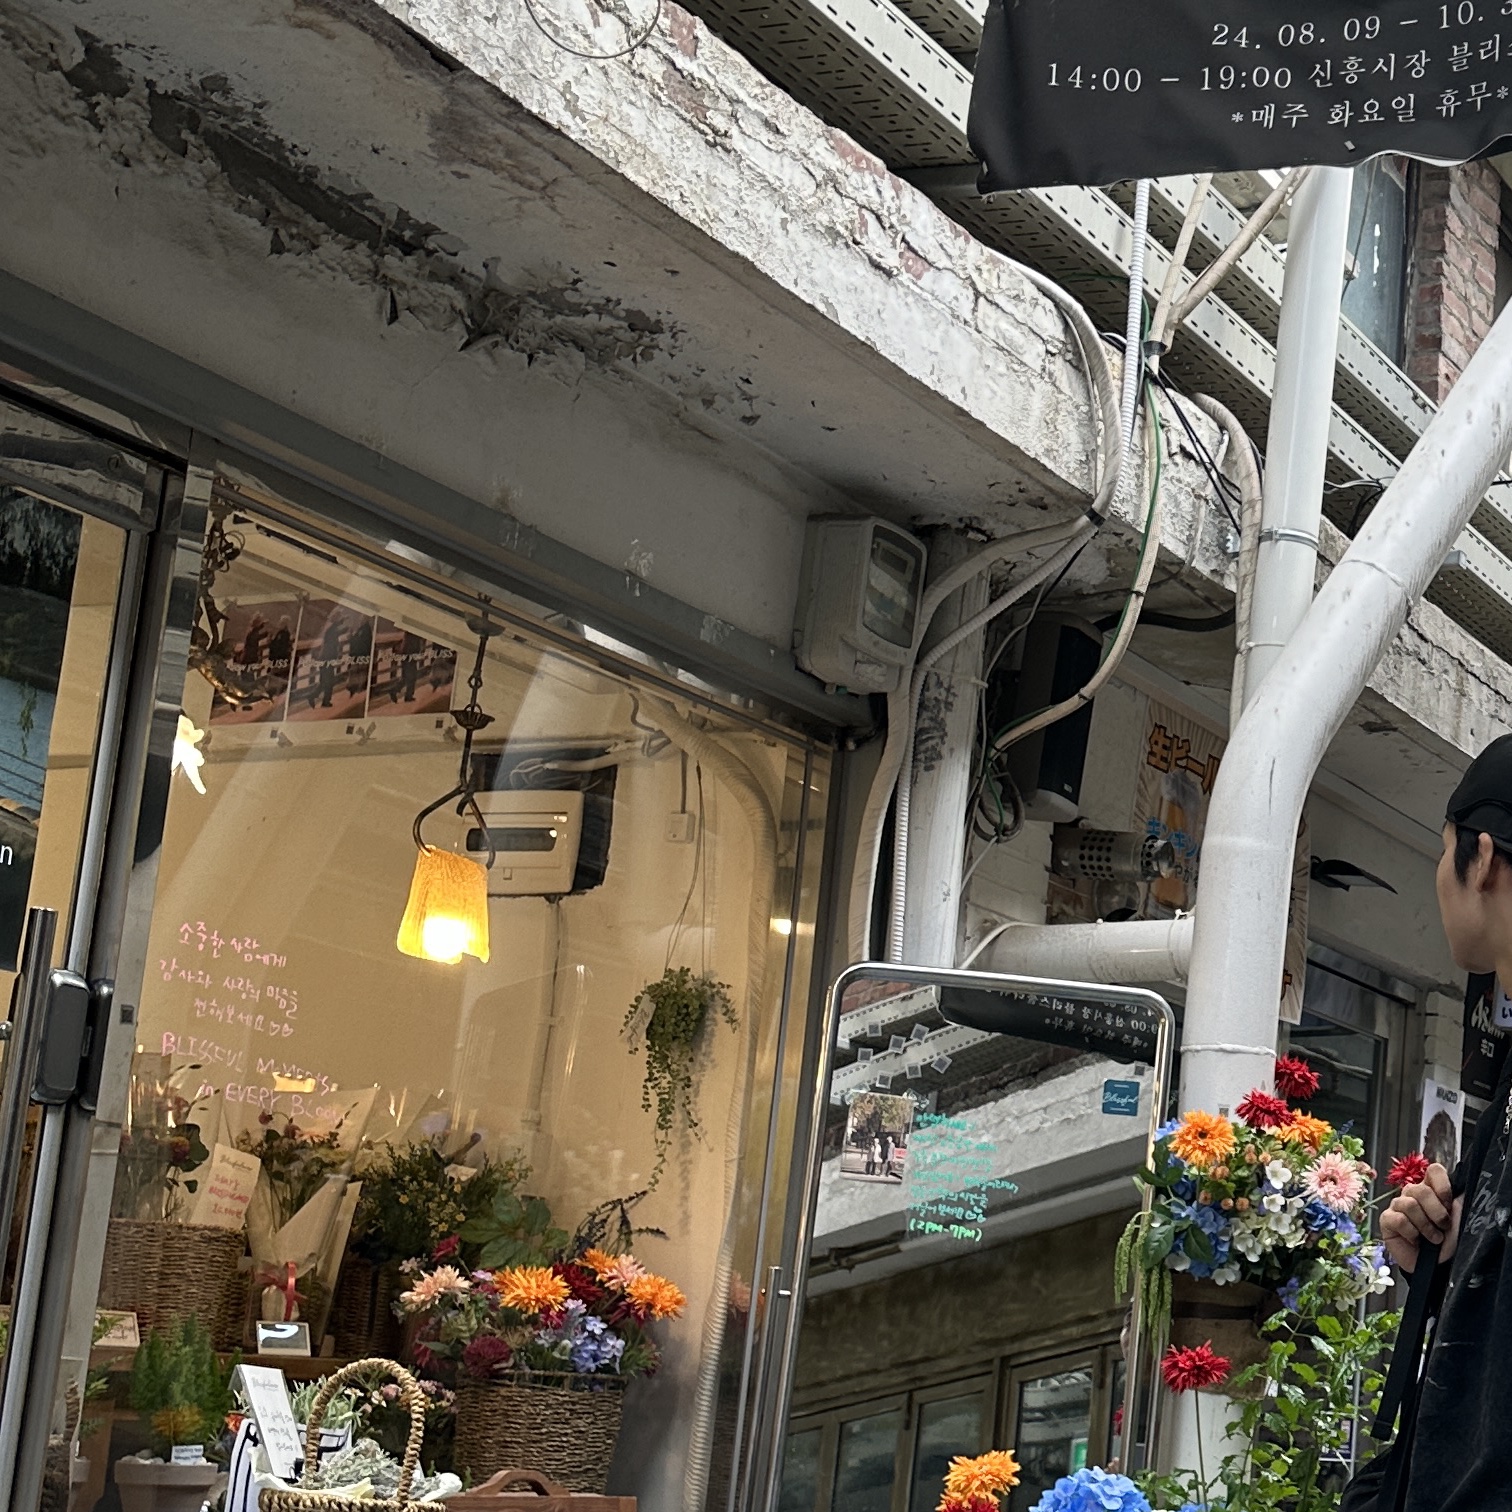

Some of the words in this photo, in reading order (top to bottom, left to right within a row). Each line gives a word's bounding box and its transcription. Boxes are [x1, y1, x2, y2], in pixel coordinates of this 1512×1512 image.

[1211, 22, 1261, 50] 24.
[1278, 22, 1326, 47] 08.
[1343, 15, 1381, 41] 09
[1438, 0, 1485, 29] 10.
[1047, 62, 1142, 93] 14:00
[1200, 64, 1292, 91] 19:00
[1308, 50, 1431, 89] 신흥시장
[1326, 92, 1418, 129] 화요일
[179, 921, 226, 959] 소중한
[230, 936, 287, 968] 사람에게
[159, 957, 213, 989] 감사와
[222, 975, 260, 1003] 사랑의
[266, 985, 298, 1020] 마음을
[225, 1082, 281, 1114] EVERY
